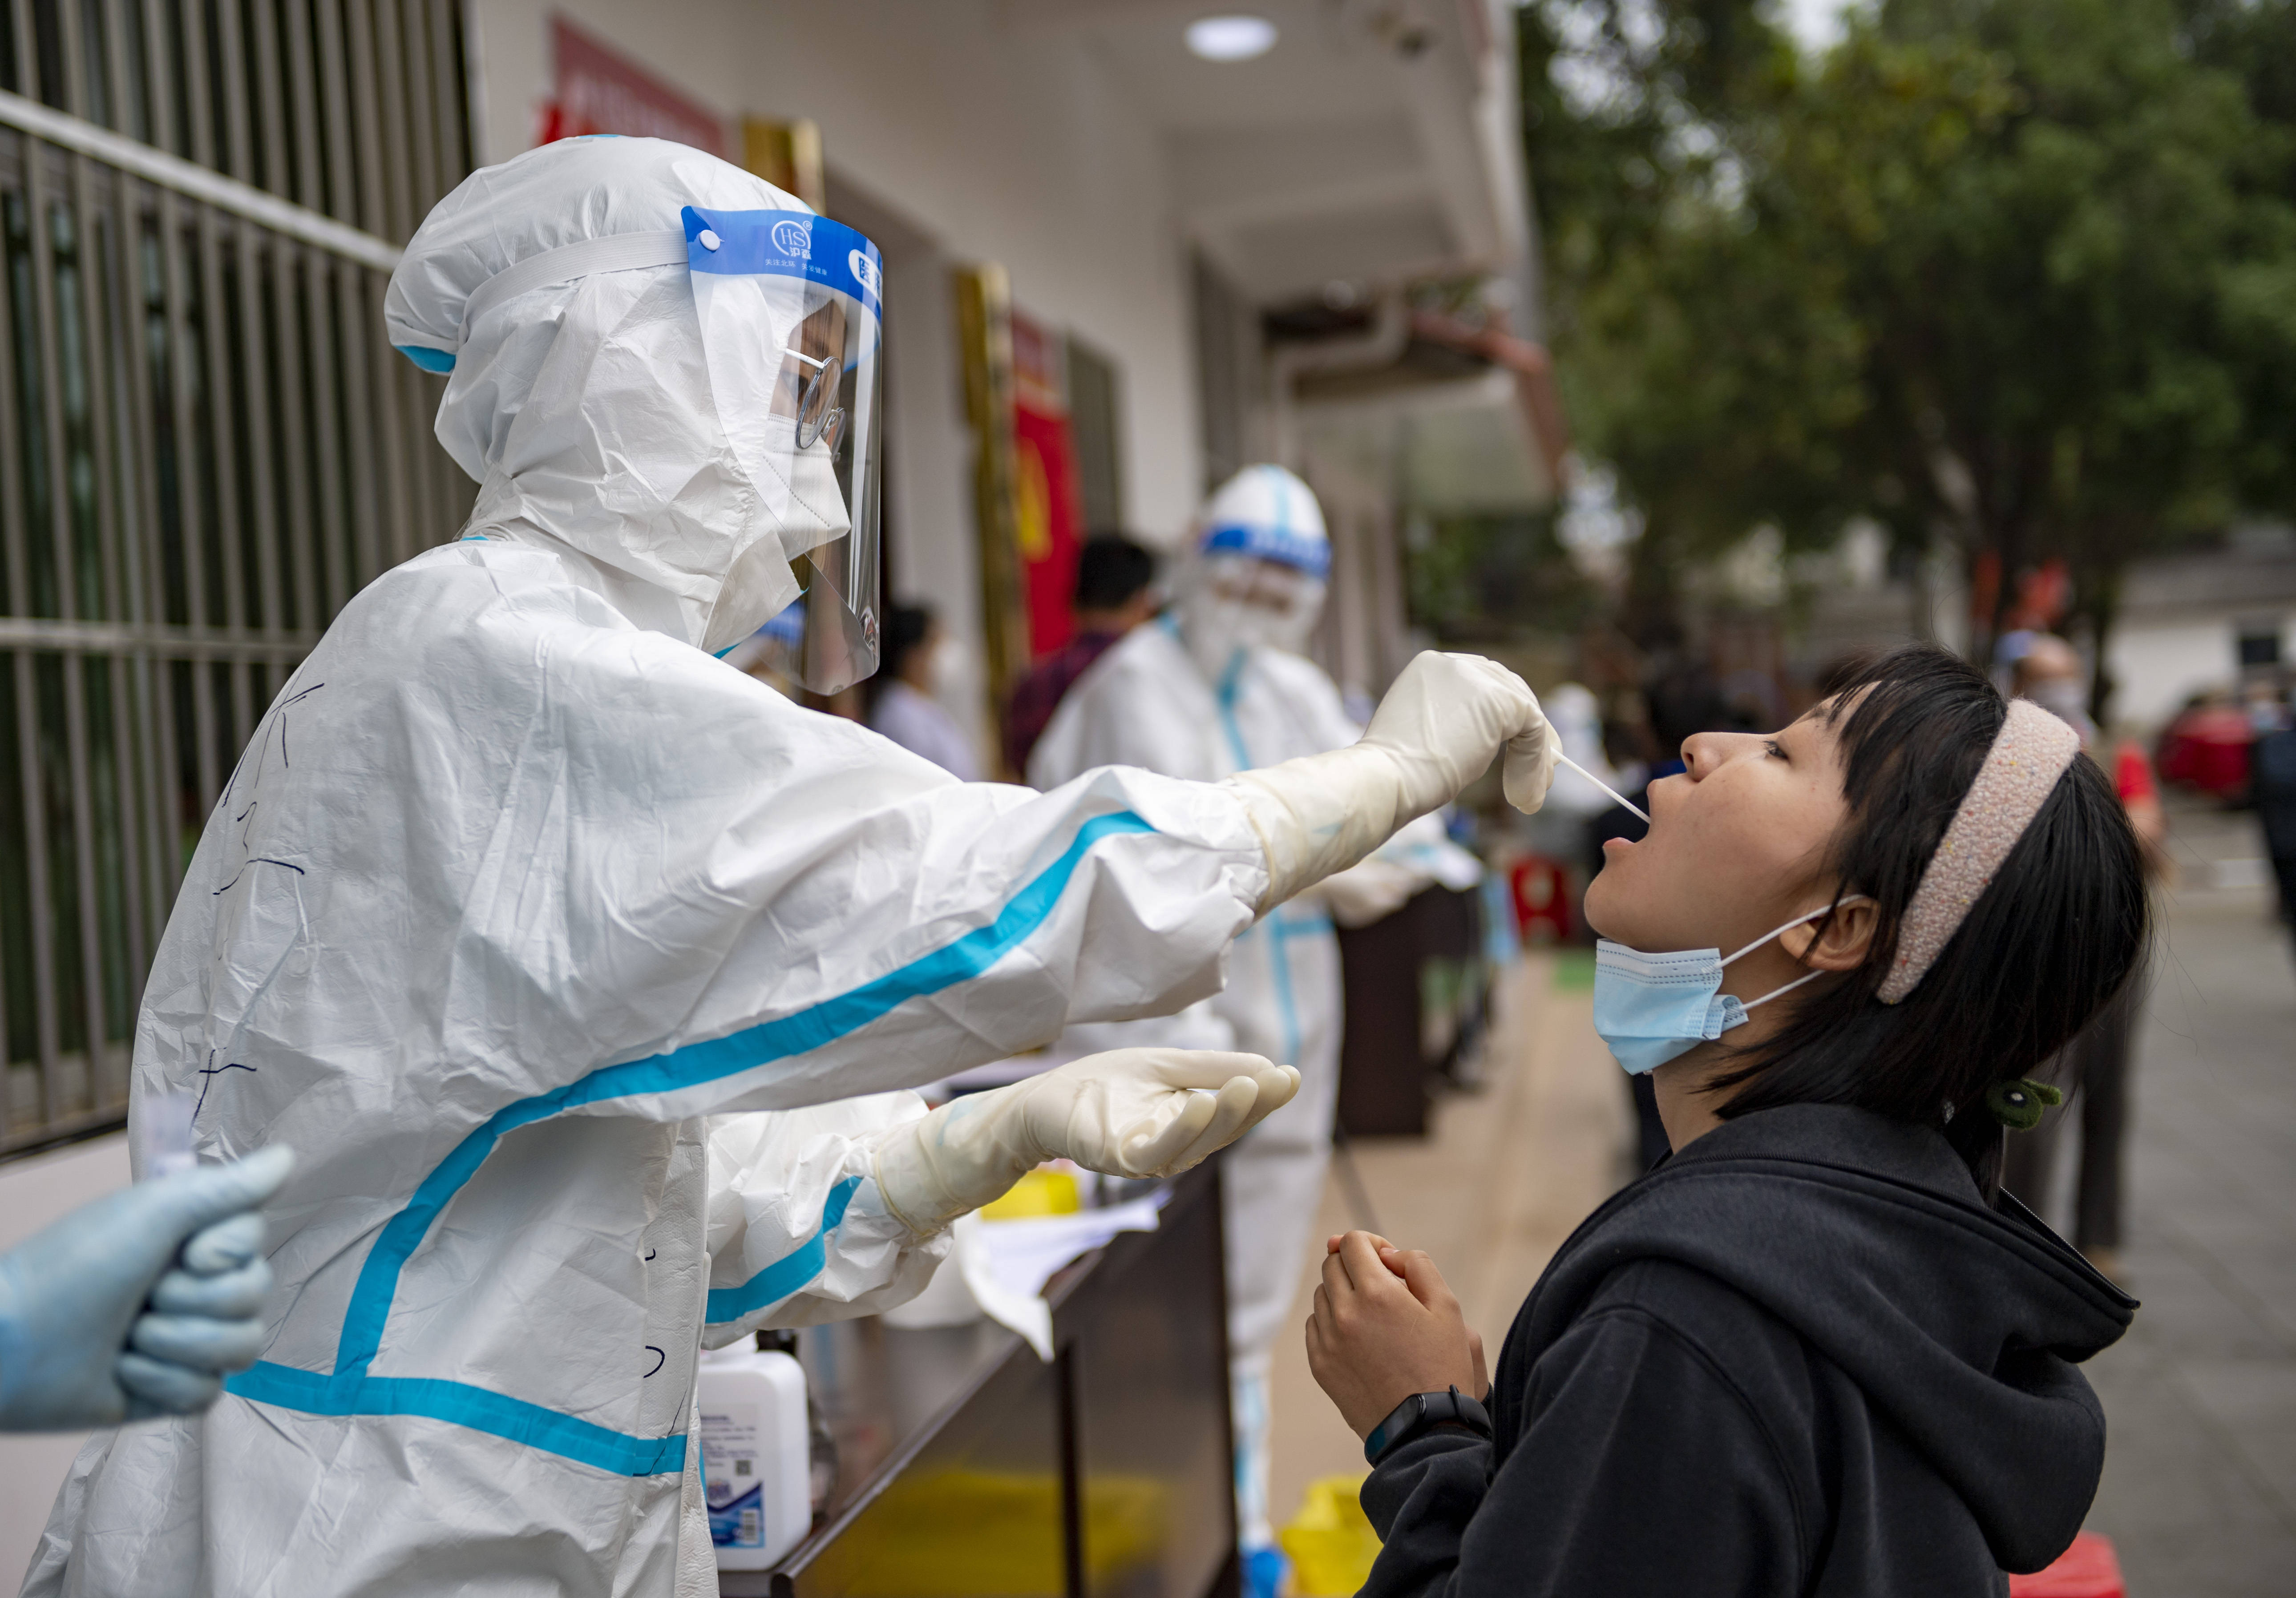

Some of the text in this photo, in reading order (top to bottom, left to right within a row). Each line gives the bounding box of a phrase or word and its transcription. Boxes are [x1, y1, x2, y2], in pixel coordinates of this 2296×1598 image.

[780, 228, 806, 247] HS
[765, 258, 828, 276] 关注北环 关爱健康
